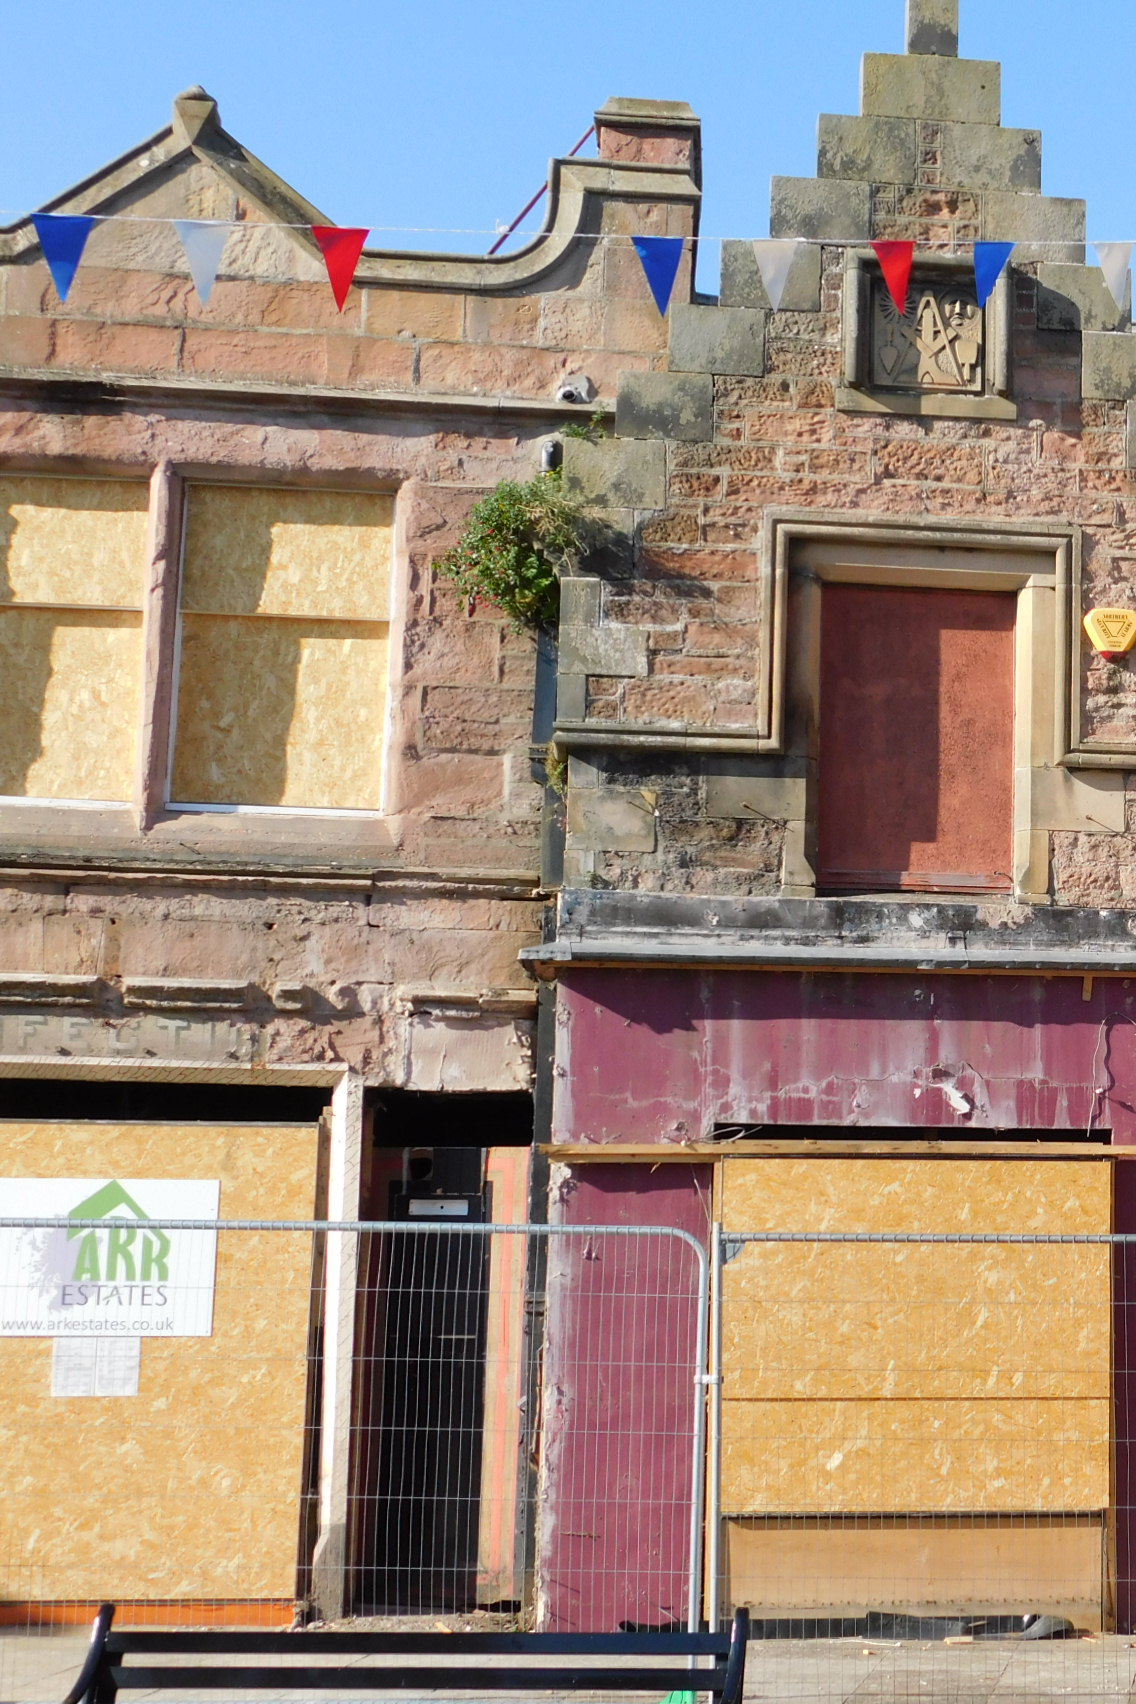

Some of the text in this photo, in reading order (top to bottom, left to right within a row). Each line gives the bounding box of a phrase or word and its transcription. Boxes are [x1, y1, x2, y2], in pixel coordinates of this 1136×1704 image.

[0, 1014, 253, 1051] FECTI
[61, 1284, 168, 1307] ESTATES
[1, 1317, 174, 1332] www.arkestates.co.uk
